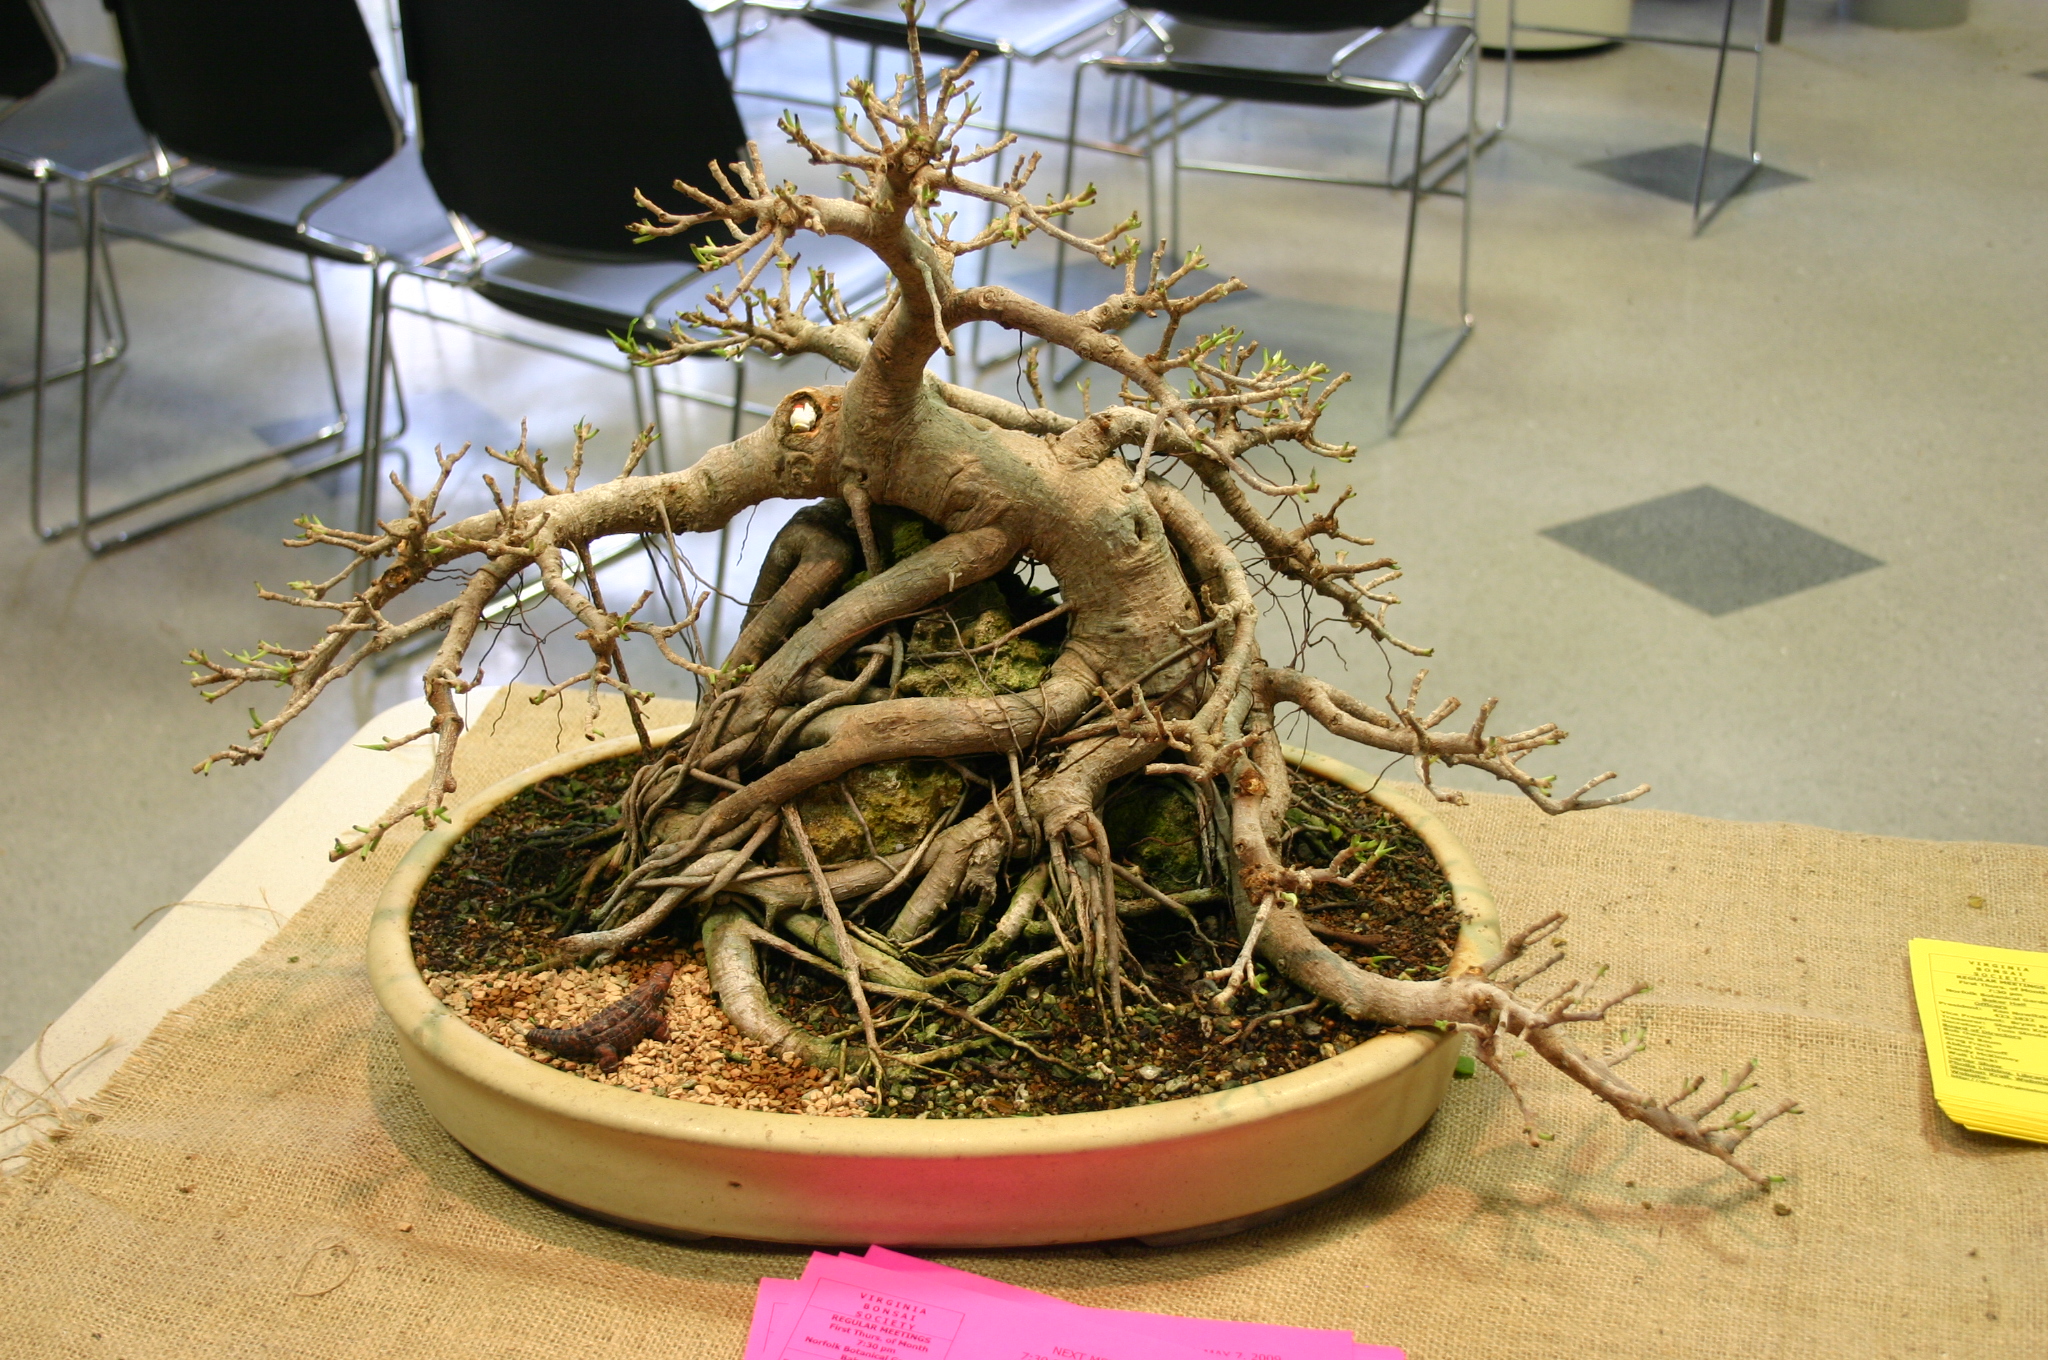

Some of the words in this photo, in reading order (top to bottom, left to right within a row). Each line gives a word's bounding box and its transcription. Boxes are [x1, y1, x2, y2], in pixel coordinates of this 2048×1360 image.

[1969, 960, 2029, 972] VIRGINIA
[1976, 967, 2022, 976] BONSAI
[1956, 975, 1996, 983] REGULAR
[1999, 980, 2046, 990] MEETINGS
[1973, 971, 2026, 982] SOCIETY
[860, 1292, 927, 1315] VIRGINIA
[863, 1303, 916, 1321] BONSAI
[831, 1314, 878, 1331] REGULAR
[880, 1326, 931, 1344] MEETINGS
[856, 1311, 916, 1330] SOCIETY
[829, 1323, 852, 1334] First
[854, 1329, 882, 1342] Thurs.
[885, 1337, 897, 1345] of
[898, 1340, 929, 1352] Month
[805, 1336, 841, 1351] Norfolk
[843, 1346, 889, 1360] Botanical
[857, 1339, 879, 1350] 7:30
[880, 1346, 896, 1355] pm
[1052, 1346, 1087, 1360] NEXT
